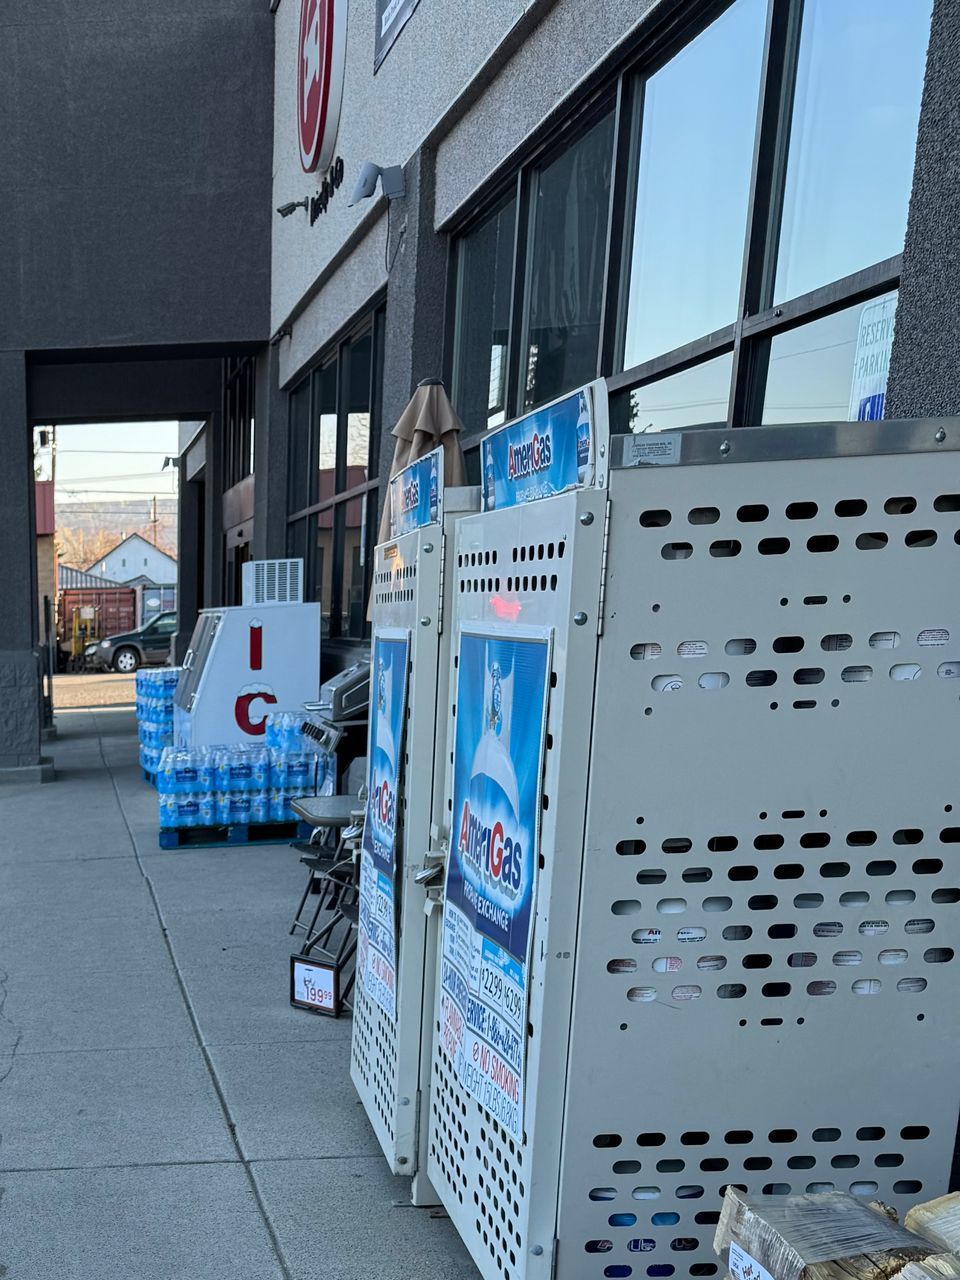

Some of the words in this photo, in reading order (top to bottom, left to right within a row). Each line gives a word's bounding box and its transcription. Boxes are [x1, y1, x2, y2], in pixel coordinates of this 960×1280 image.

[860, 314, 896, 348] RESERVE
[857, 348, 891, 379] PARKIN
[508, 432, 552, 481] AmeriGas
[458, 799, 524, 917] AmeriGas
[477, 899, 509, 932] EXCHANGE
[479, 1043, 491, 1075] NO
[491, 1053, 520, 1106] SMOKING
